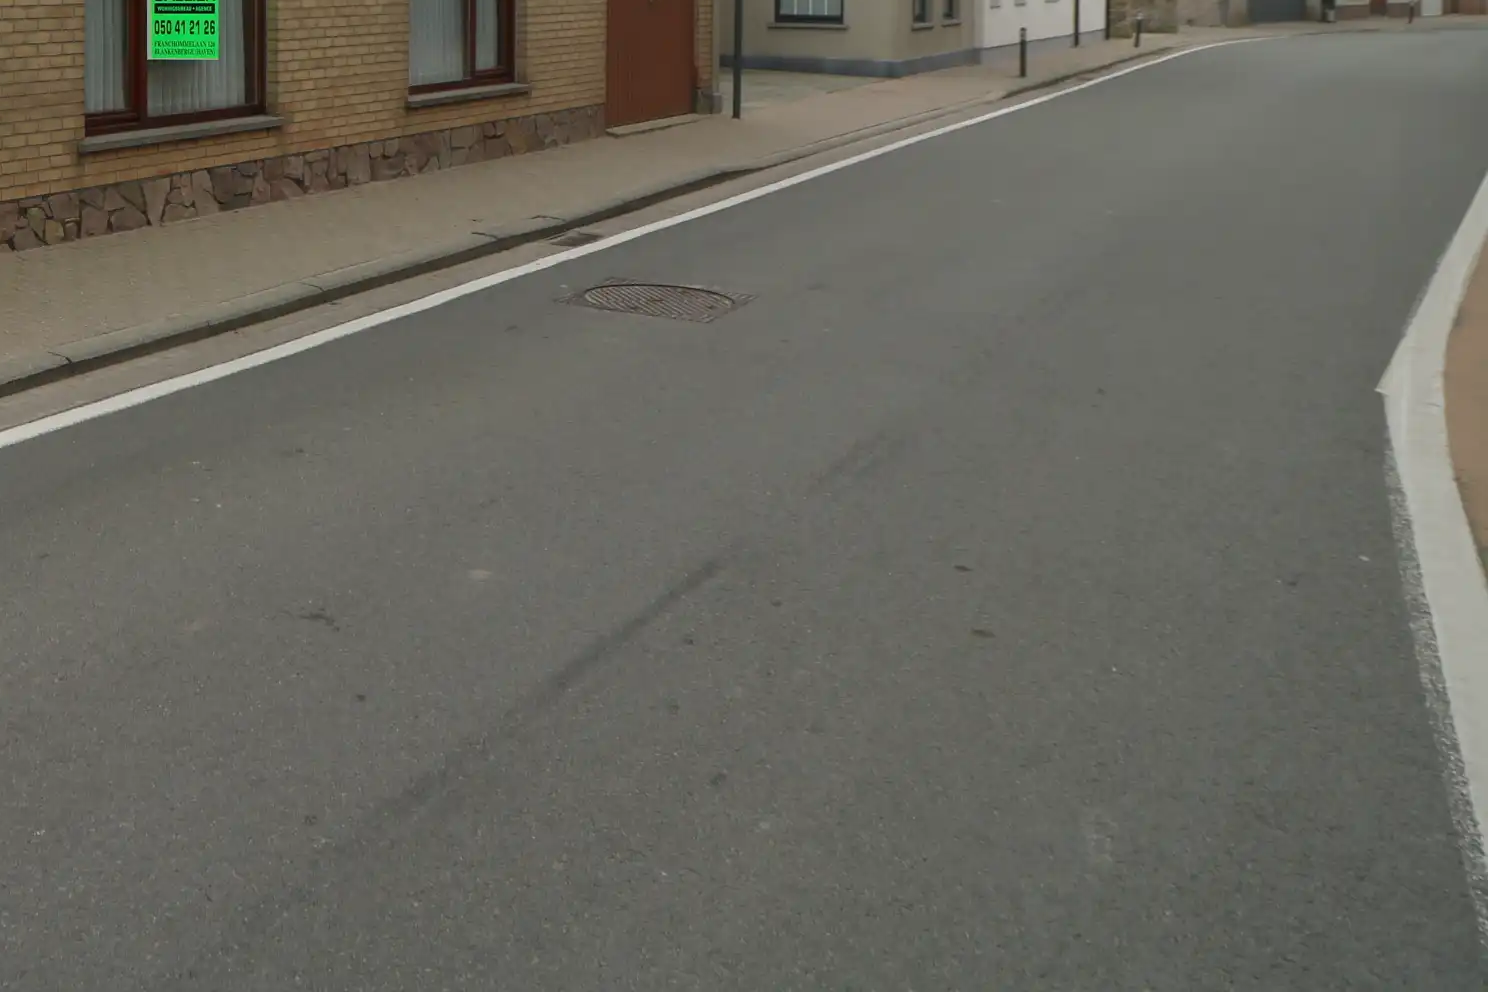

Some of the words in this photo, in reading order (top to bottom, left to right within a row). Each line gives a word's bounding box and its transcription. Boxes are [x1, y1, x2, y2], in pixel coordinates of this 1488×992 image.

[154, 20, 172, 35] 050
[175, 20, 186, 35] 41
[189, 20, 200, 35] 21
[203, 20, 215, 35] 26
